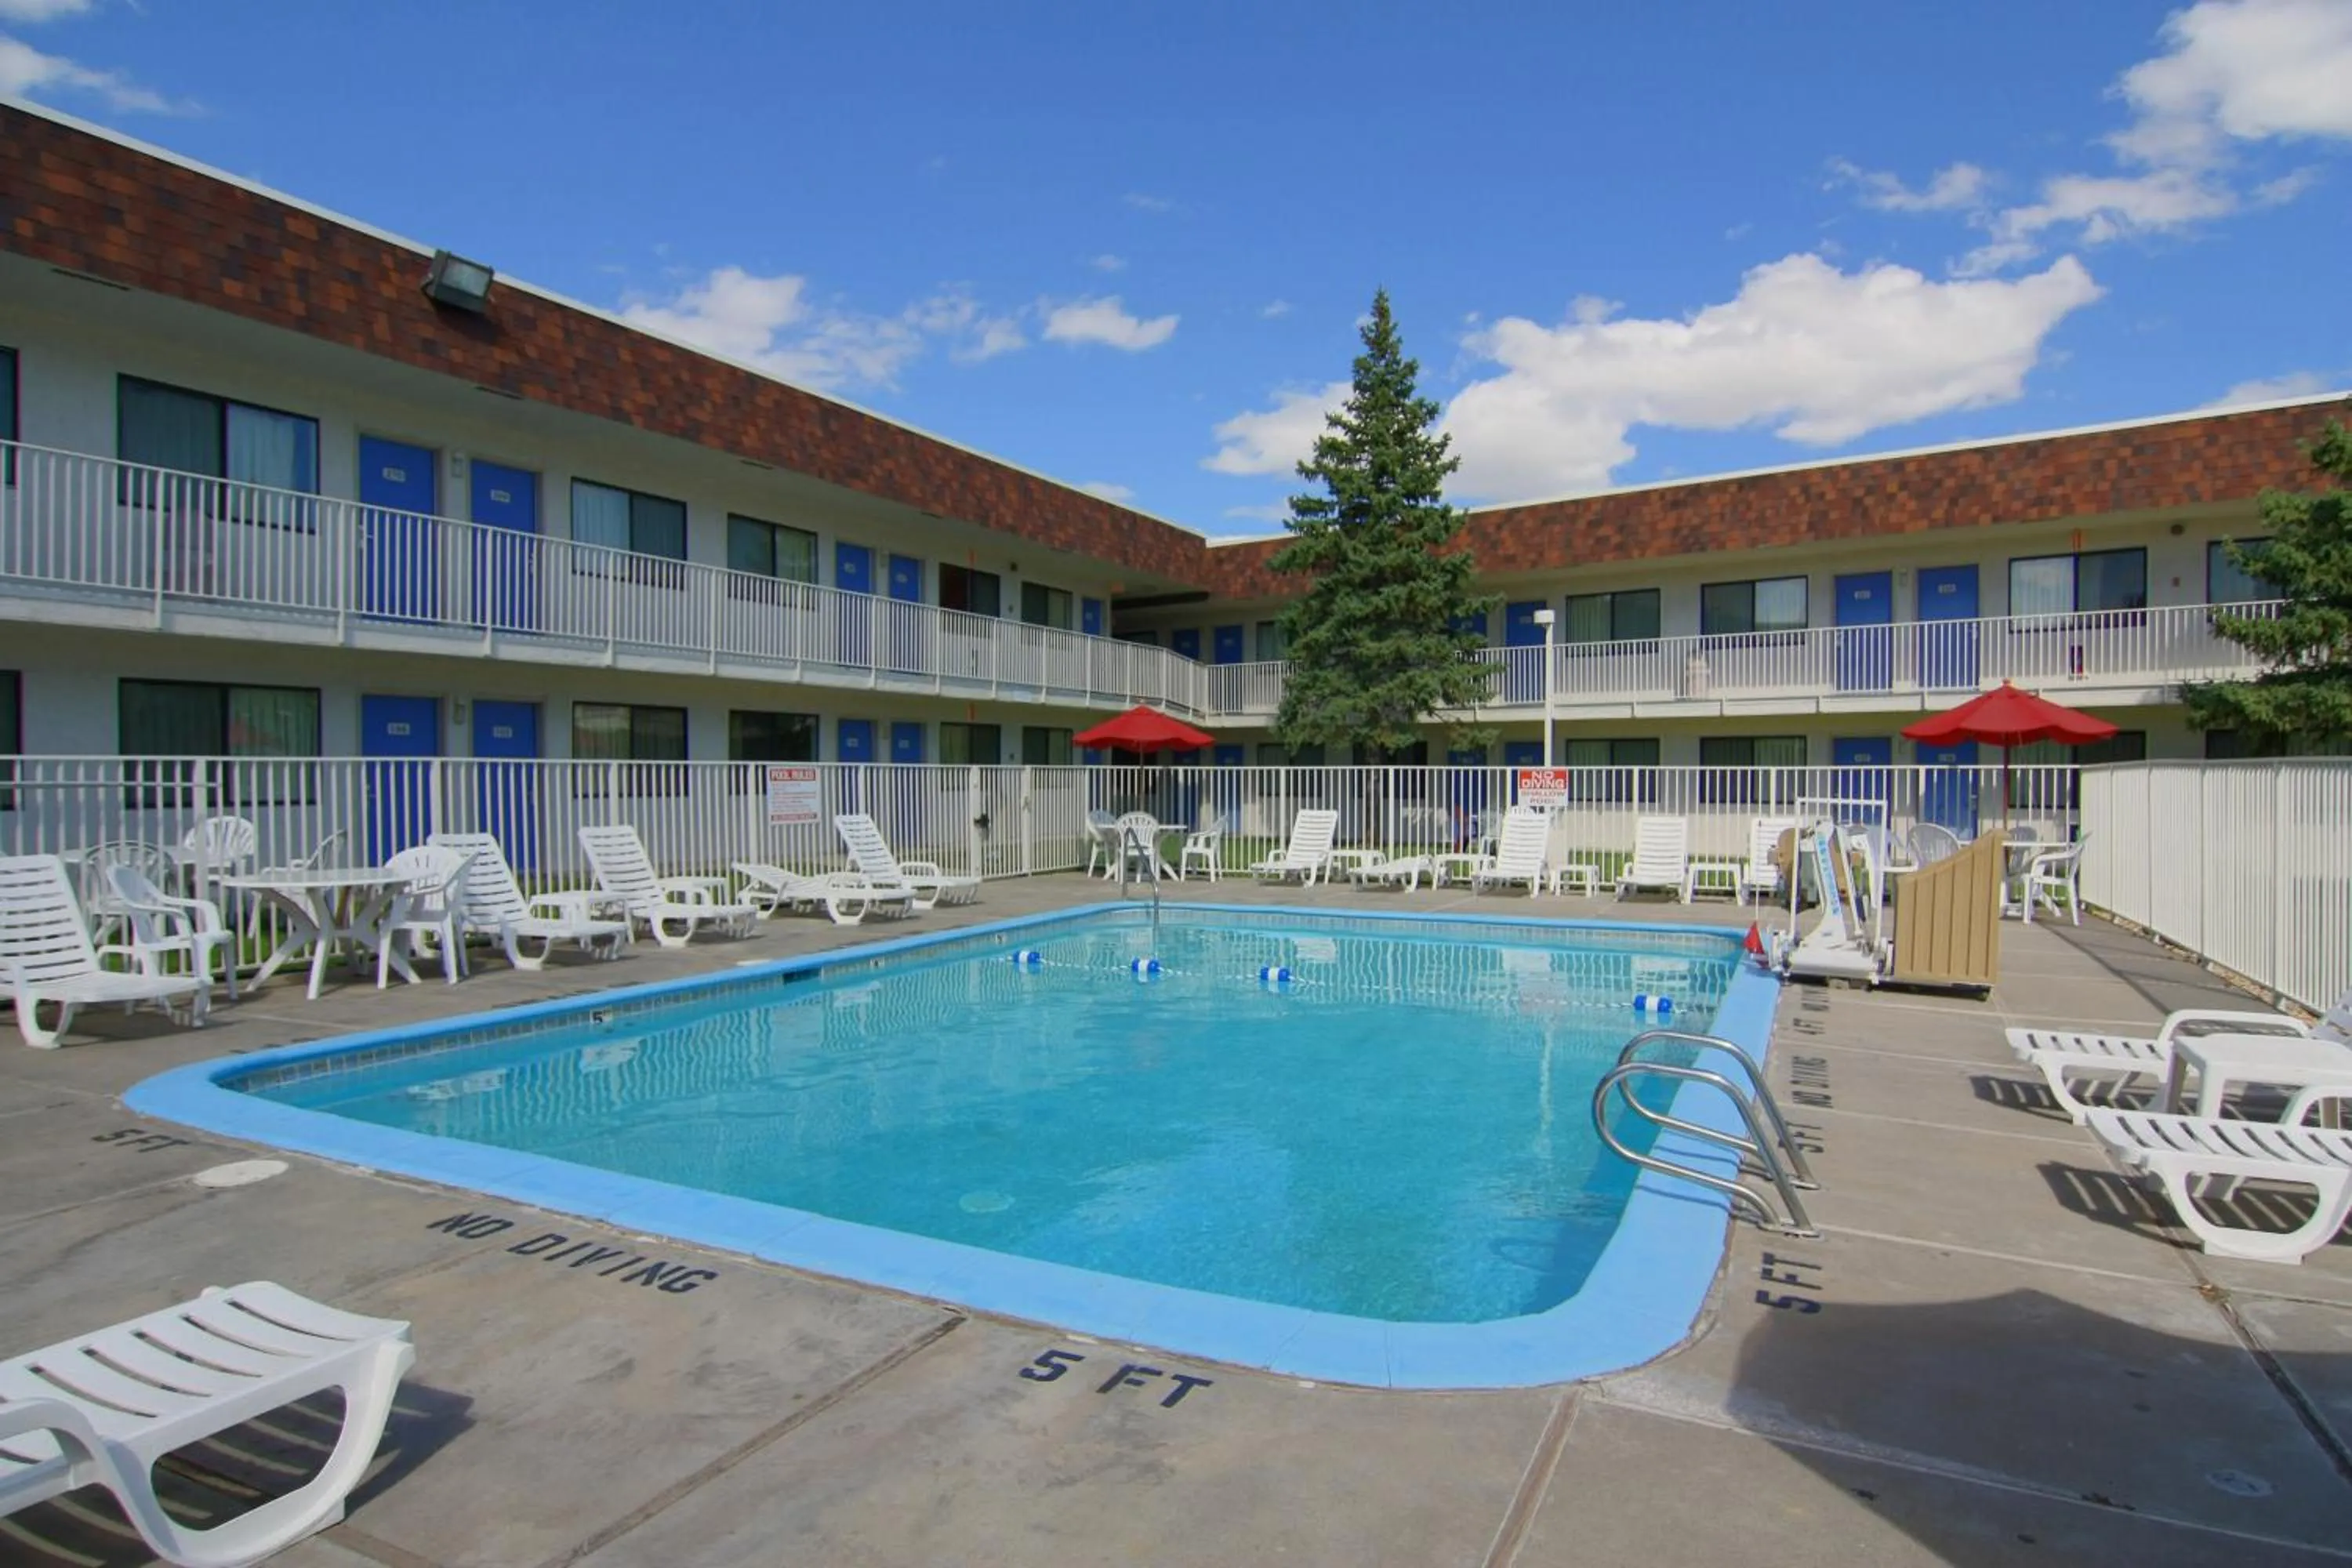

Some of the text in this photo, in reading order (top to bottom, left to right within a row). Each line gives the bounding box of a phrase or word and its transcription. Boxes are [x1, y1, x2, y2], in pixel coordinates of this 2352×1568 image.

[771, 770, 791, 780] POOL
[1522, 779, 1565, 789] DIVING
[1531, 771, 1555, 779] NO
[426, 1212, 718, 1294] NO DIVING
[1755, 1252, 1823, 1314] 5 FT
[1018, 1349, 1214, 1408] 5 FT
